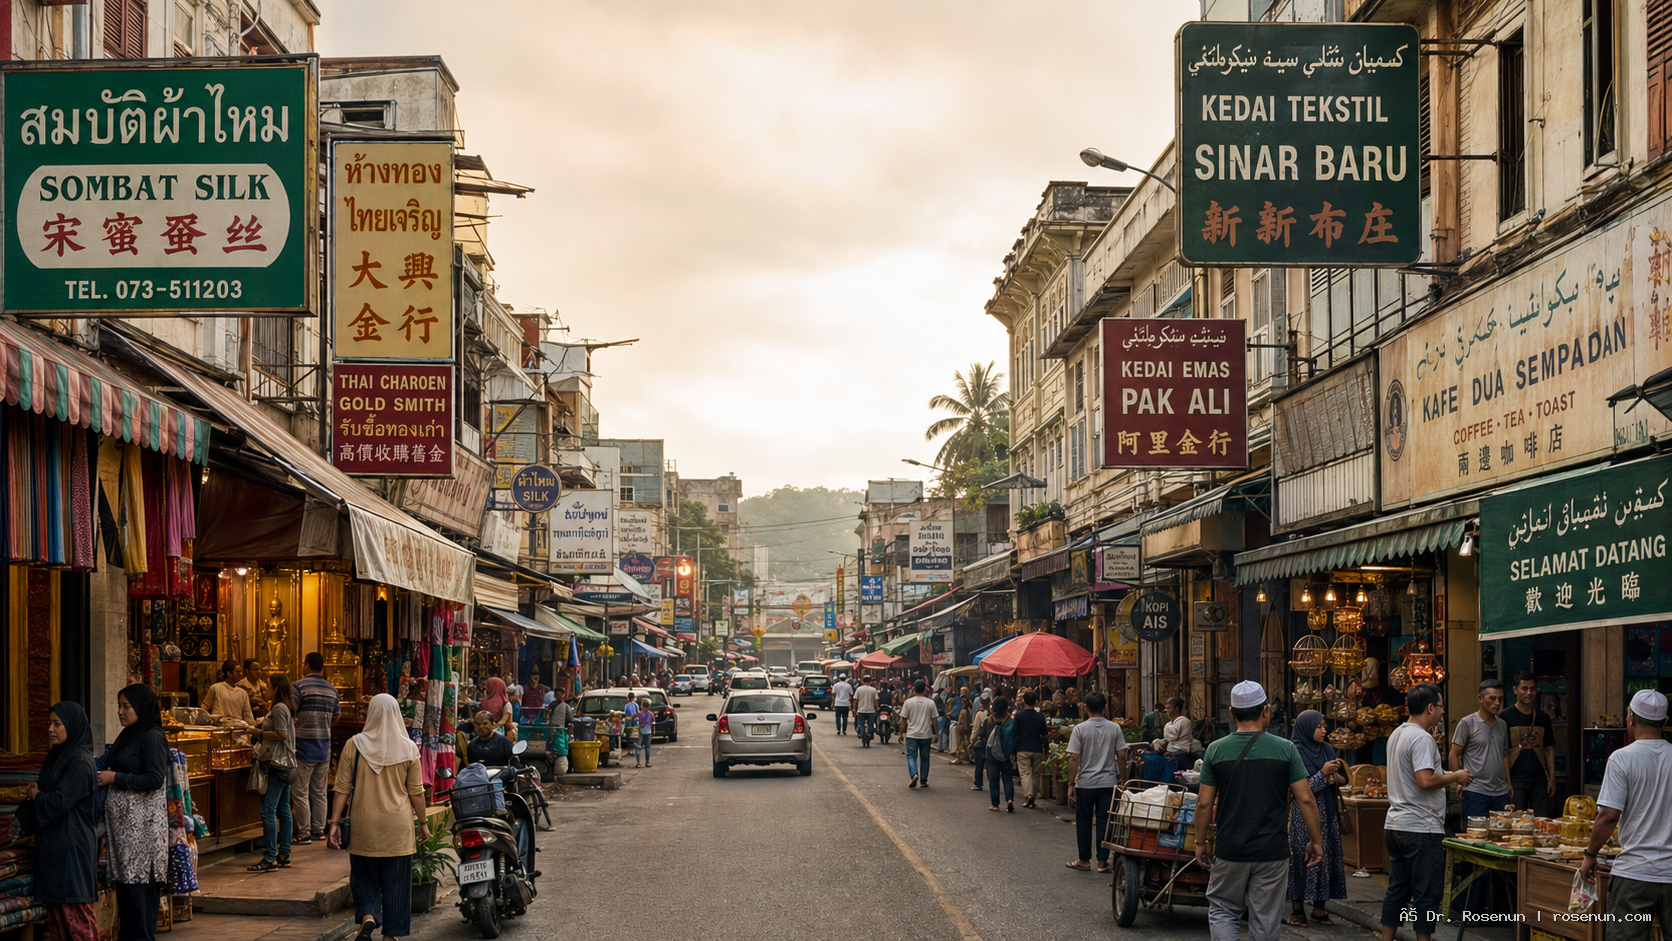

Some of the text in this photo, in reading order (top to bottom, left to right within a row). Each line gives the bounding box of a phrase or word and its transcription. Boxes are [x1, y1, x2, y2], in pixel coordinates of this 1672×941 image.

[20, 83, 289, 146] สมบัติผ้าไหม
[1202, 94, 1389, 123] KEDAI TEKSTIL
[344, 152, 442, 184] ห้างทอง
[1194, 143, 1407, 182] SINAR BARU
[39, 174, 271, 202] SOMBAT SILK
[343, 195, 442, 241] ไทยเจริญ
[1200, 199, 1399, 249] 新新布庄
[39, 212, 268, 258] 宋蜜蚕丝
[348, 250, 439, 291] 大興
[64, 279, 243, 300] TEL. 073-511203
[346, 302, 440, 345] 金行
[339, 374, 446, 391] THAI CHAROEN
[1121, 360, 1230, 378] KEDAI EMAS
[1423, 316, 1627, 424] KAFE DUA SEMPADAN
[339, 396, 446, 412] GOLD SMITH
[1121, 387, 1230, 415] PAK ALI
[339, 413, 445, 438] รับซื้อทองเก่า
[1453, 390, 1576, 446] COFFEE TEA TOAST
[339, 442, 446, 463] 高價收購舊金
[1117, 428, 1232, 456] 阿里金行
[522, 490, 549, 502] SILK
[1509, 534, 1667, 582] SELAMAT DATANG
[1145, 602, 1169, 613] KOPI
[1524, 571, 1642, 615] 歡迎光臨
[1142, 615, 1168, 629] AIS
